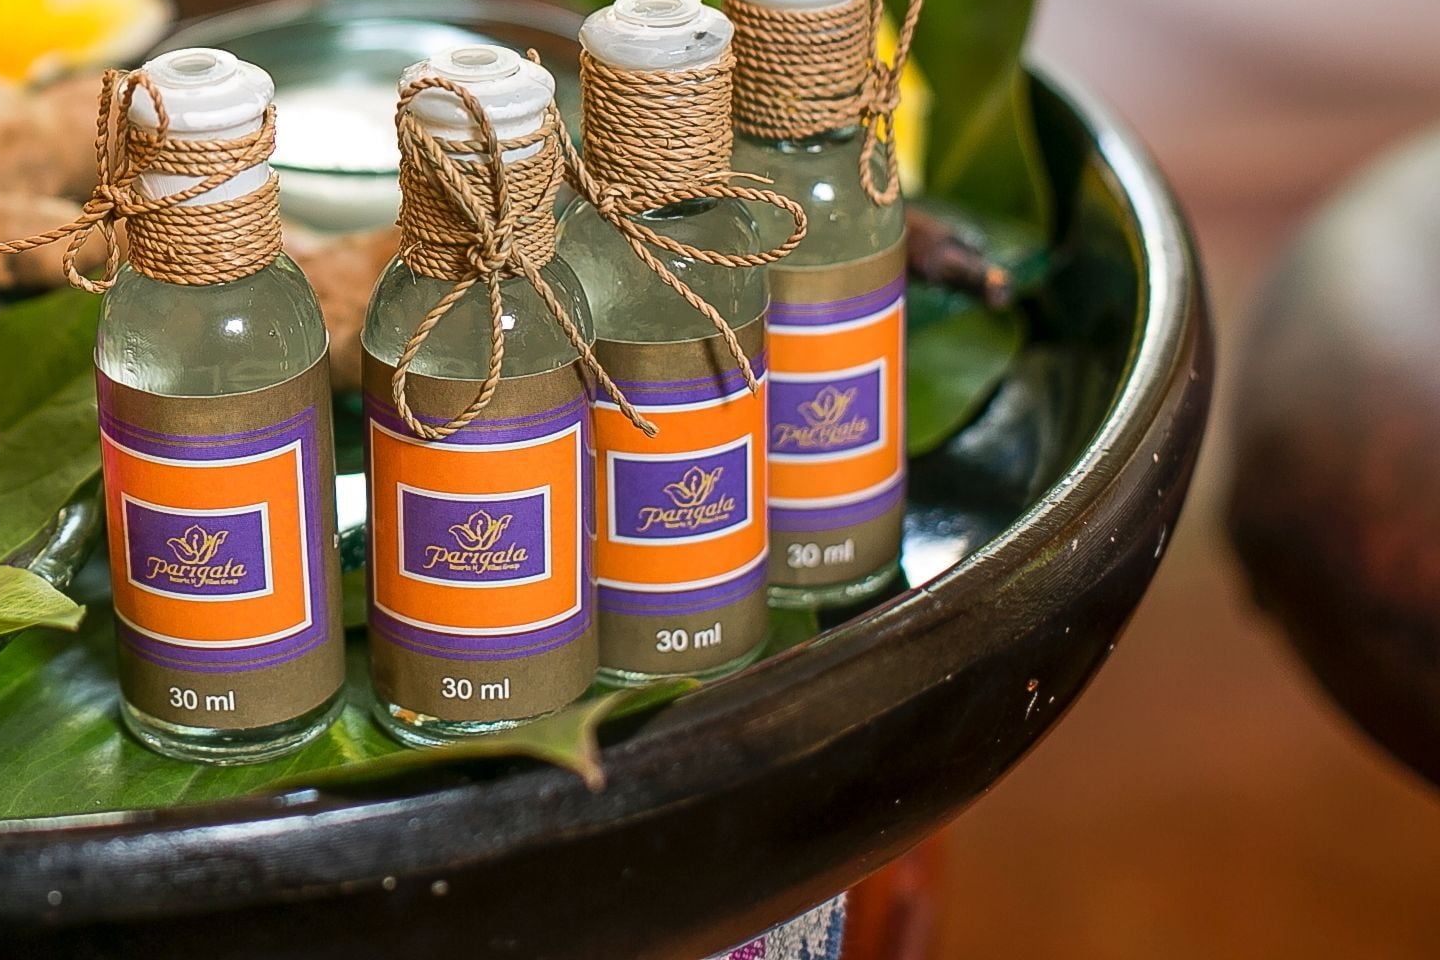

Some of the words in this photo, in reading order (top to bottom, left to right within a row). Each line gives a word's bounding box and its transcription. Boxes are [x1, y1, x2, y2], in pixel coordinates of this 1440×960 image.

[637, 493, 736, 532] Parigata
[423, 542, 529, 574] Parigata
[787, 543, 821, 568] 30
[823, 538, 855, 565] ml
[146, 557, 247, 588] Parigata
[656, 629, 689, 653] 30
[694, 622, 722, 648] ml
[169, 687, 198, 710] 30
[205, 690, 235, 711] ml
[441, 677, 473, 700] 30
[480, 678, 510, 700] ml
